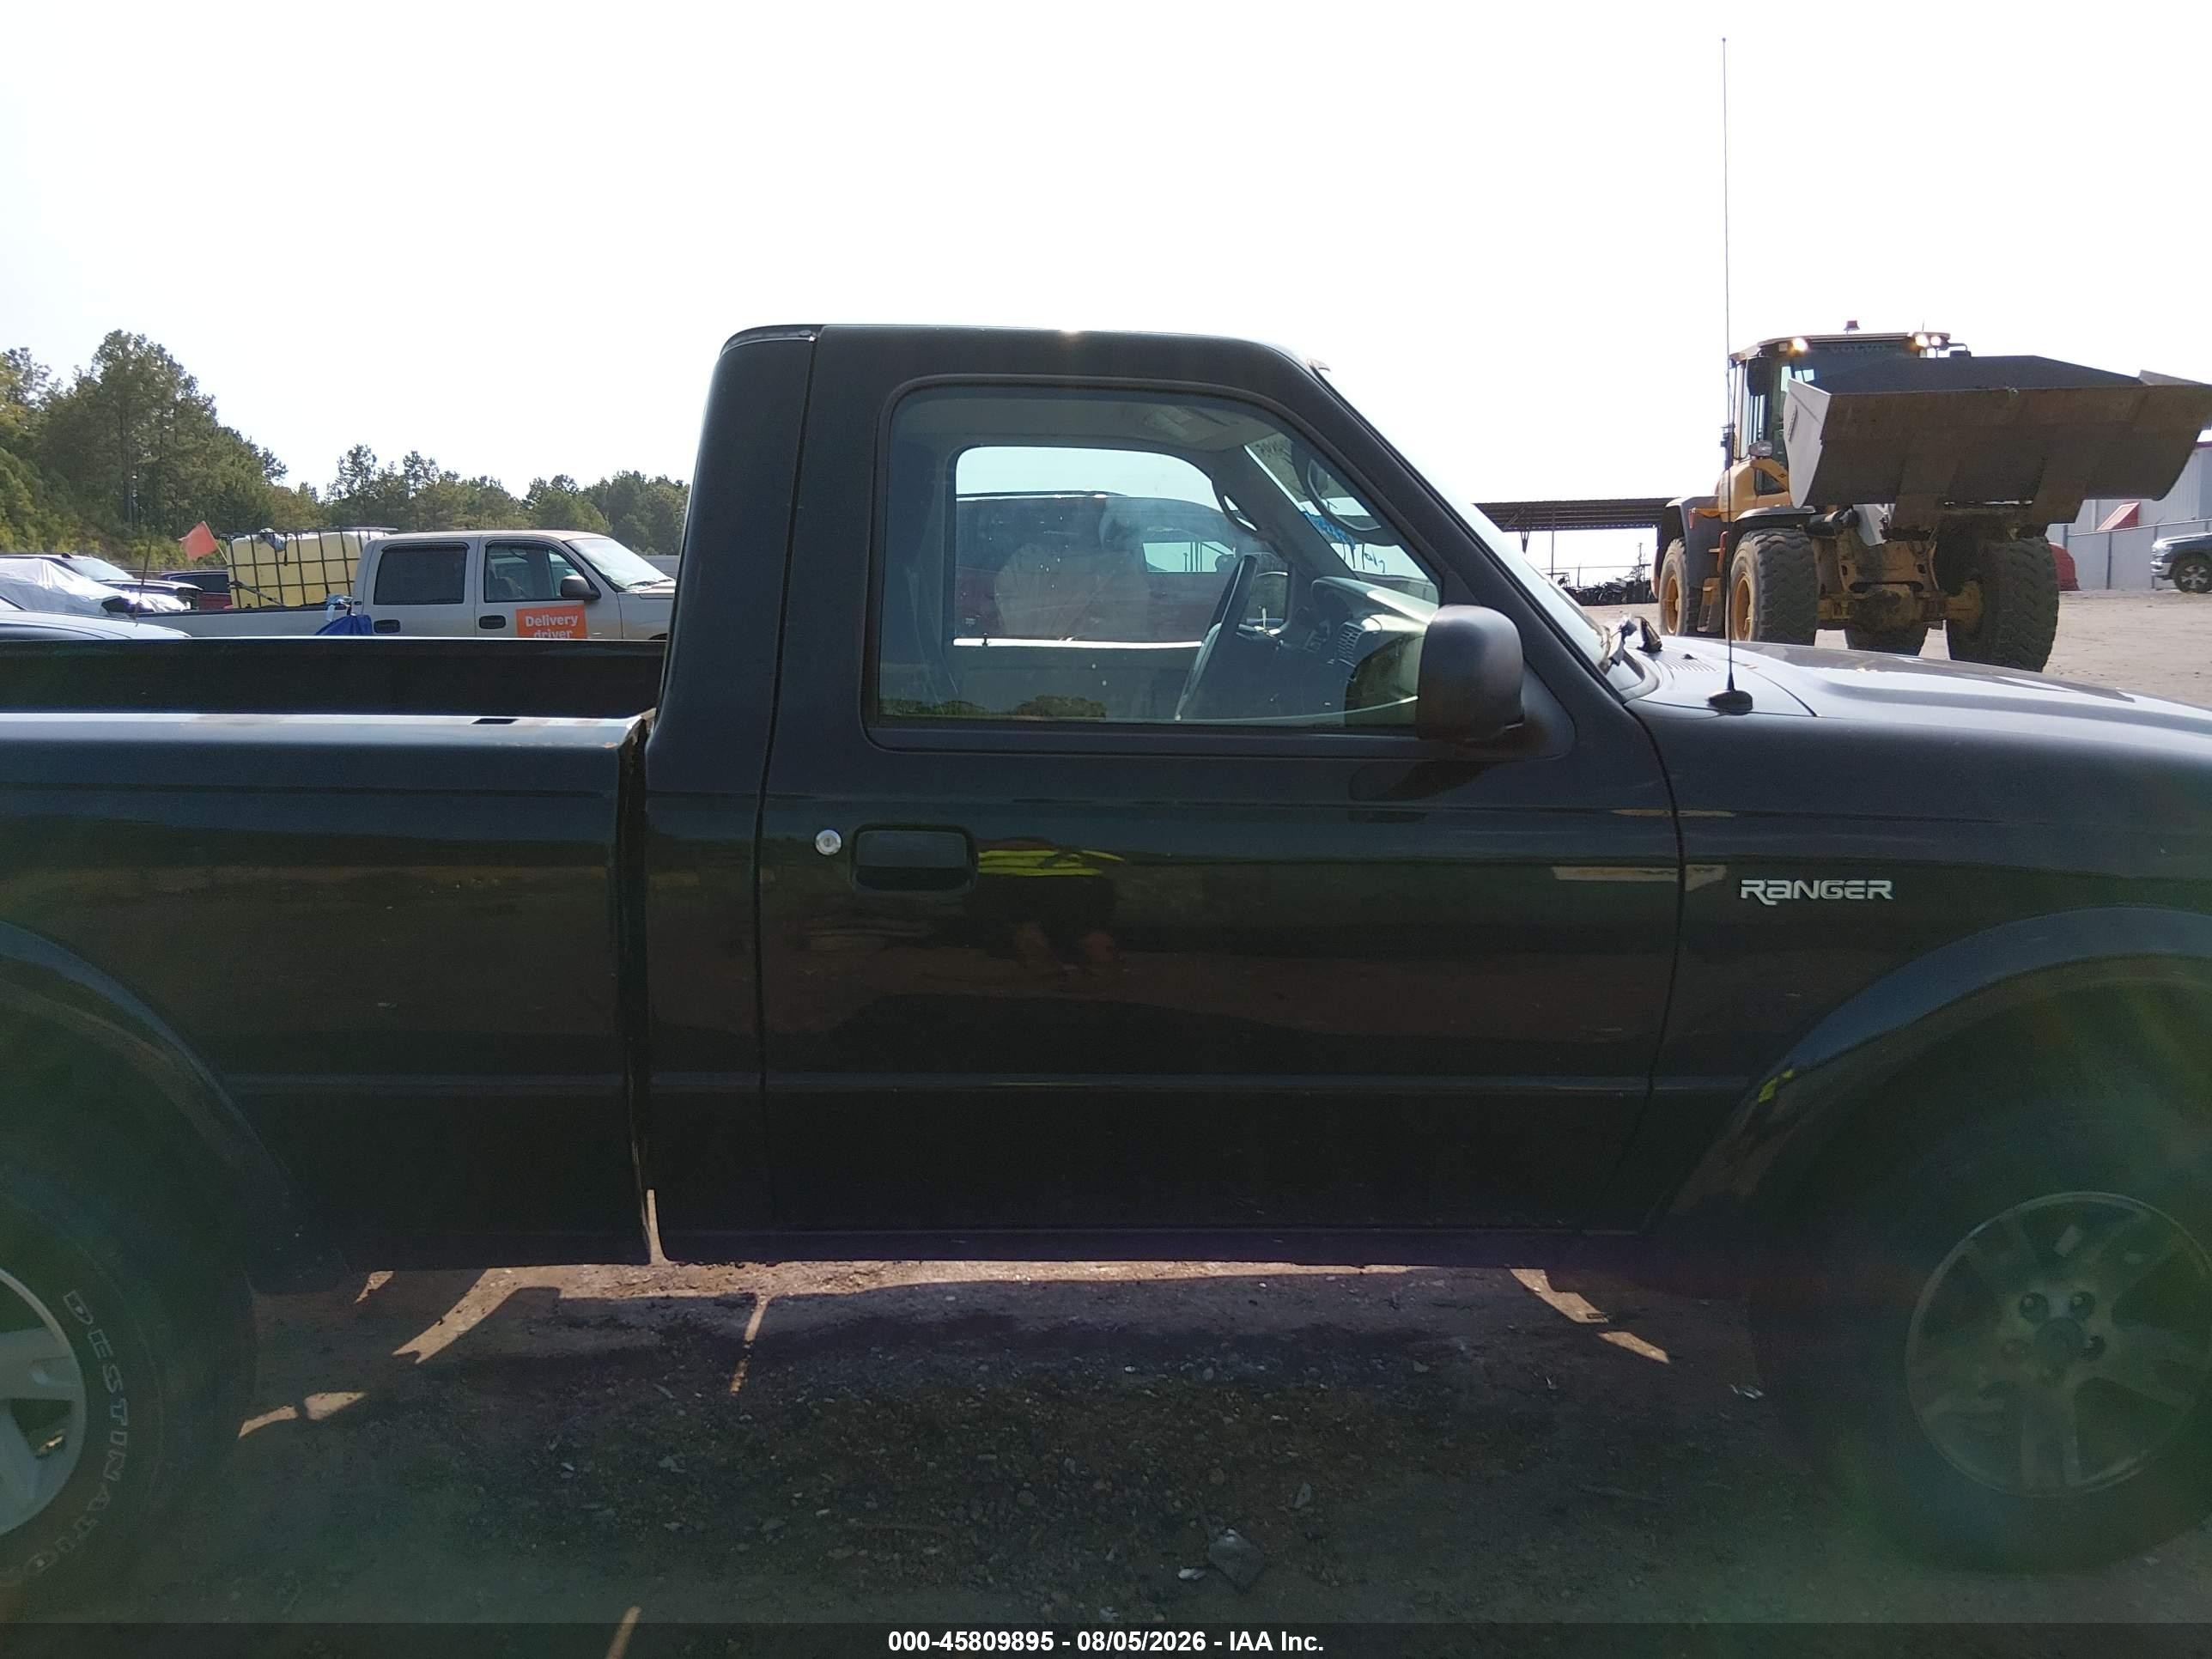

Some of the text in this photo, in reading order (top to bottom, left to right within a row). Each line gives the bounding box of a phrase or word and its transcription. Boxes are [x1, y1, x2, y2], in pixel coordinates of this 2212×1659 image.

[525, 615, 578, 628] Delivery
[533, 629, 573, 639] driver
[1740, 879, 1894, 906] RANGER
